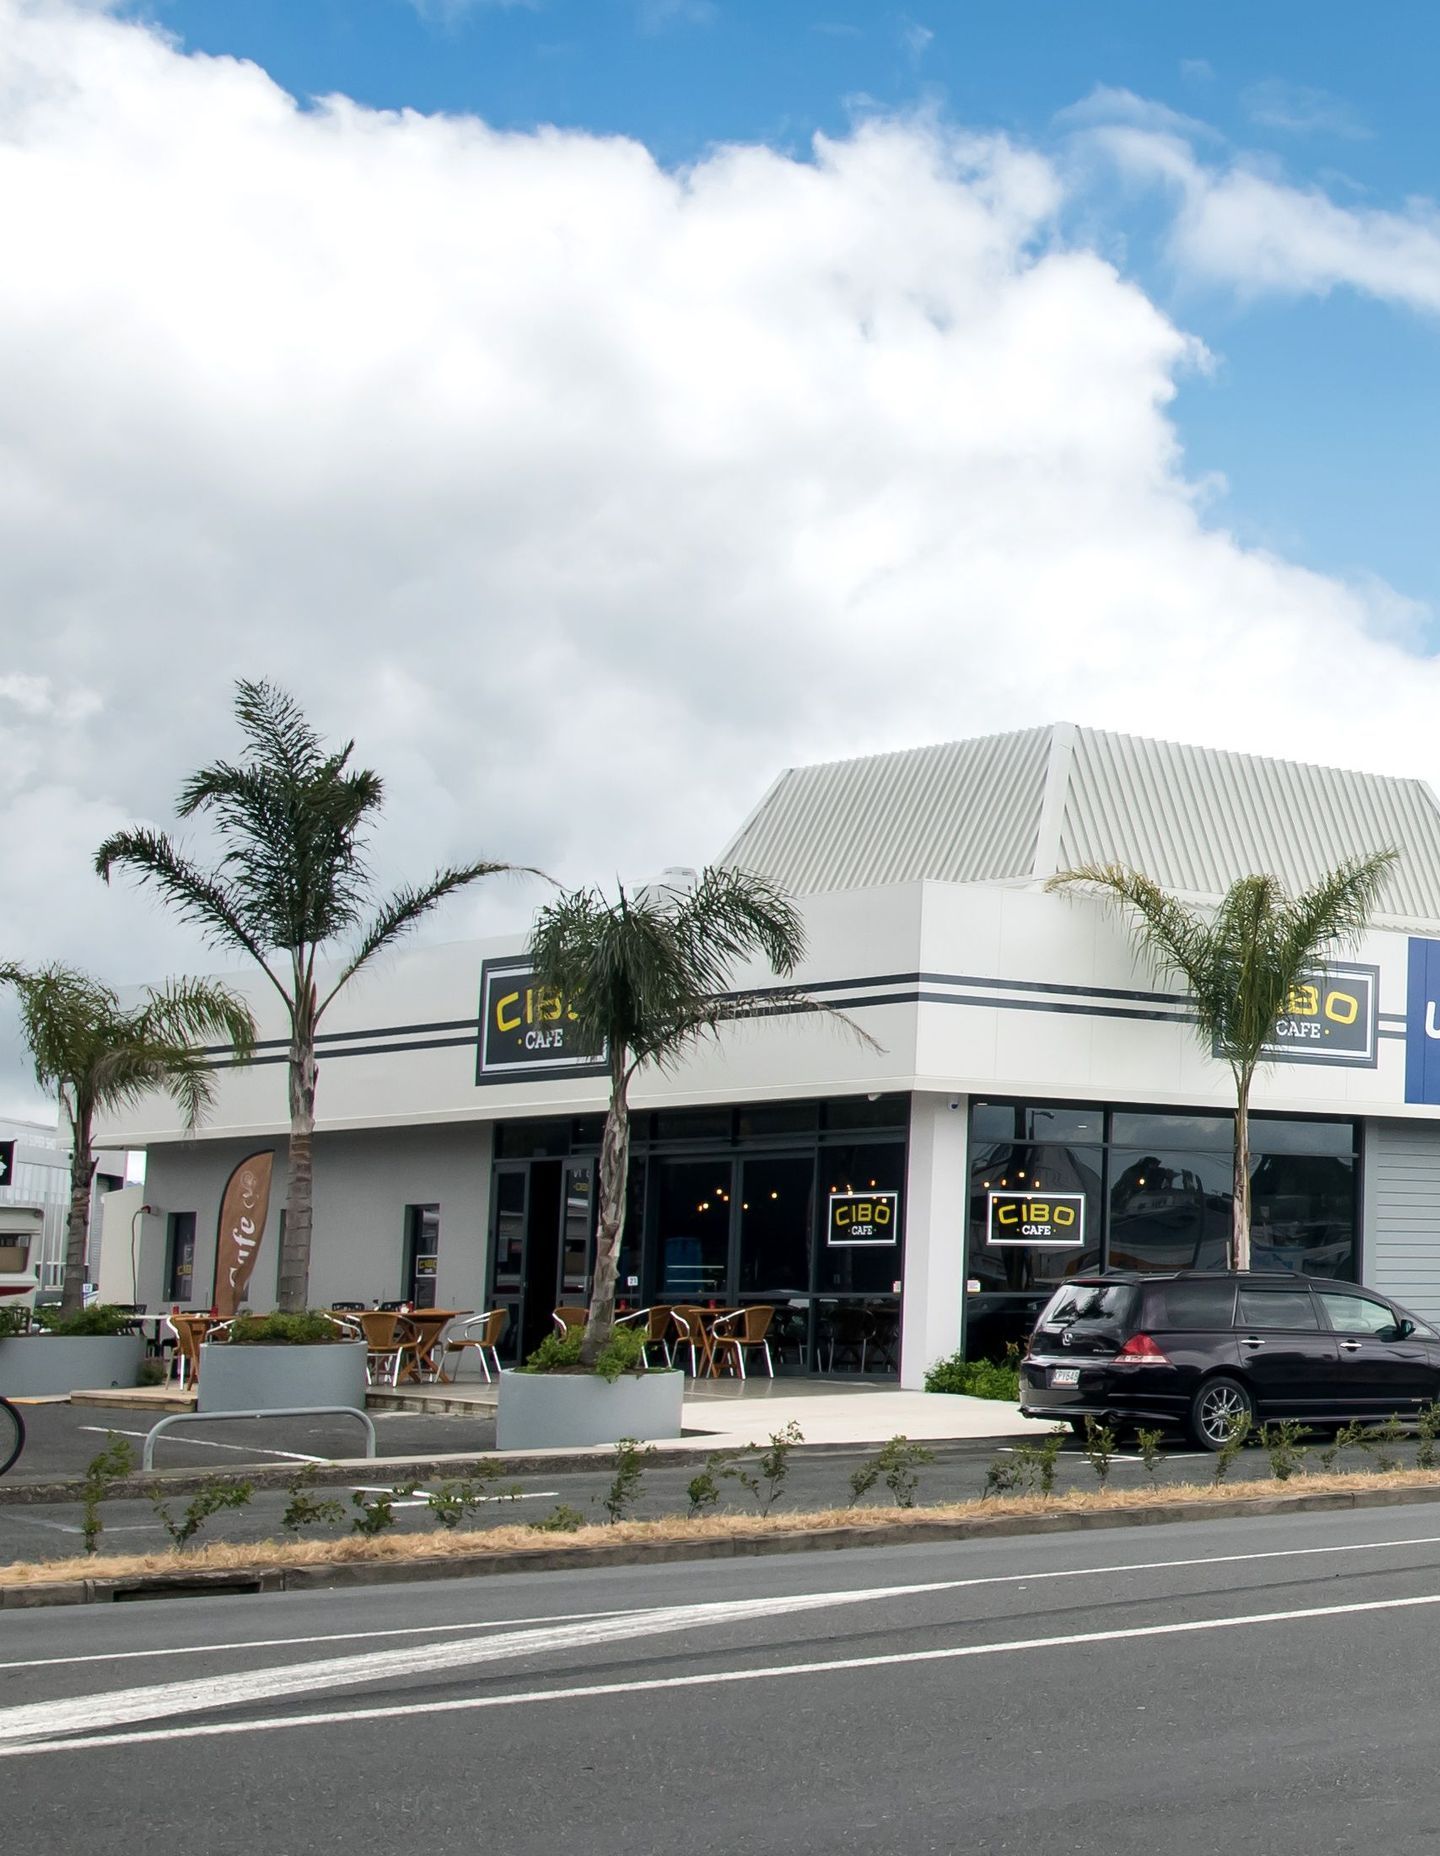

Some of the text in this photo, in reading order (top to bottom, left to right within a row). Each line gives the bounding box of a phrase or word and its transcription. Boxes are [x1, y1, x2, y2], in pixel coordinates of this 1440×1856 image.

[496, 987, 580, 1032] CIB
[525, 1029, 563, 1049] CAFE
[1276, 1020, 1321, 1038] CAFE
[835, 1203, 890, 1227] CIBO
[998, 1203, 1075, 1227] CIBO
[851, 1225, 873, 1236] CAFE
[1021, 1225, 1052, 1236] CAFE
